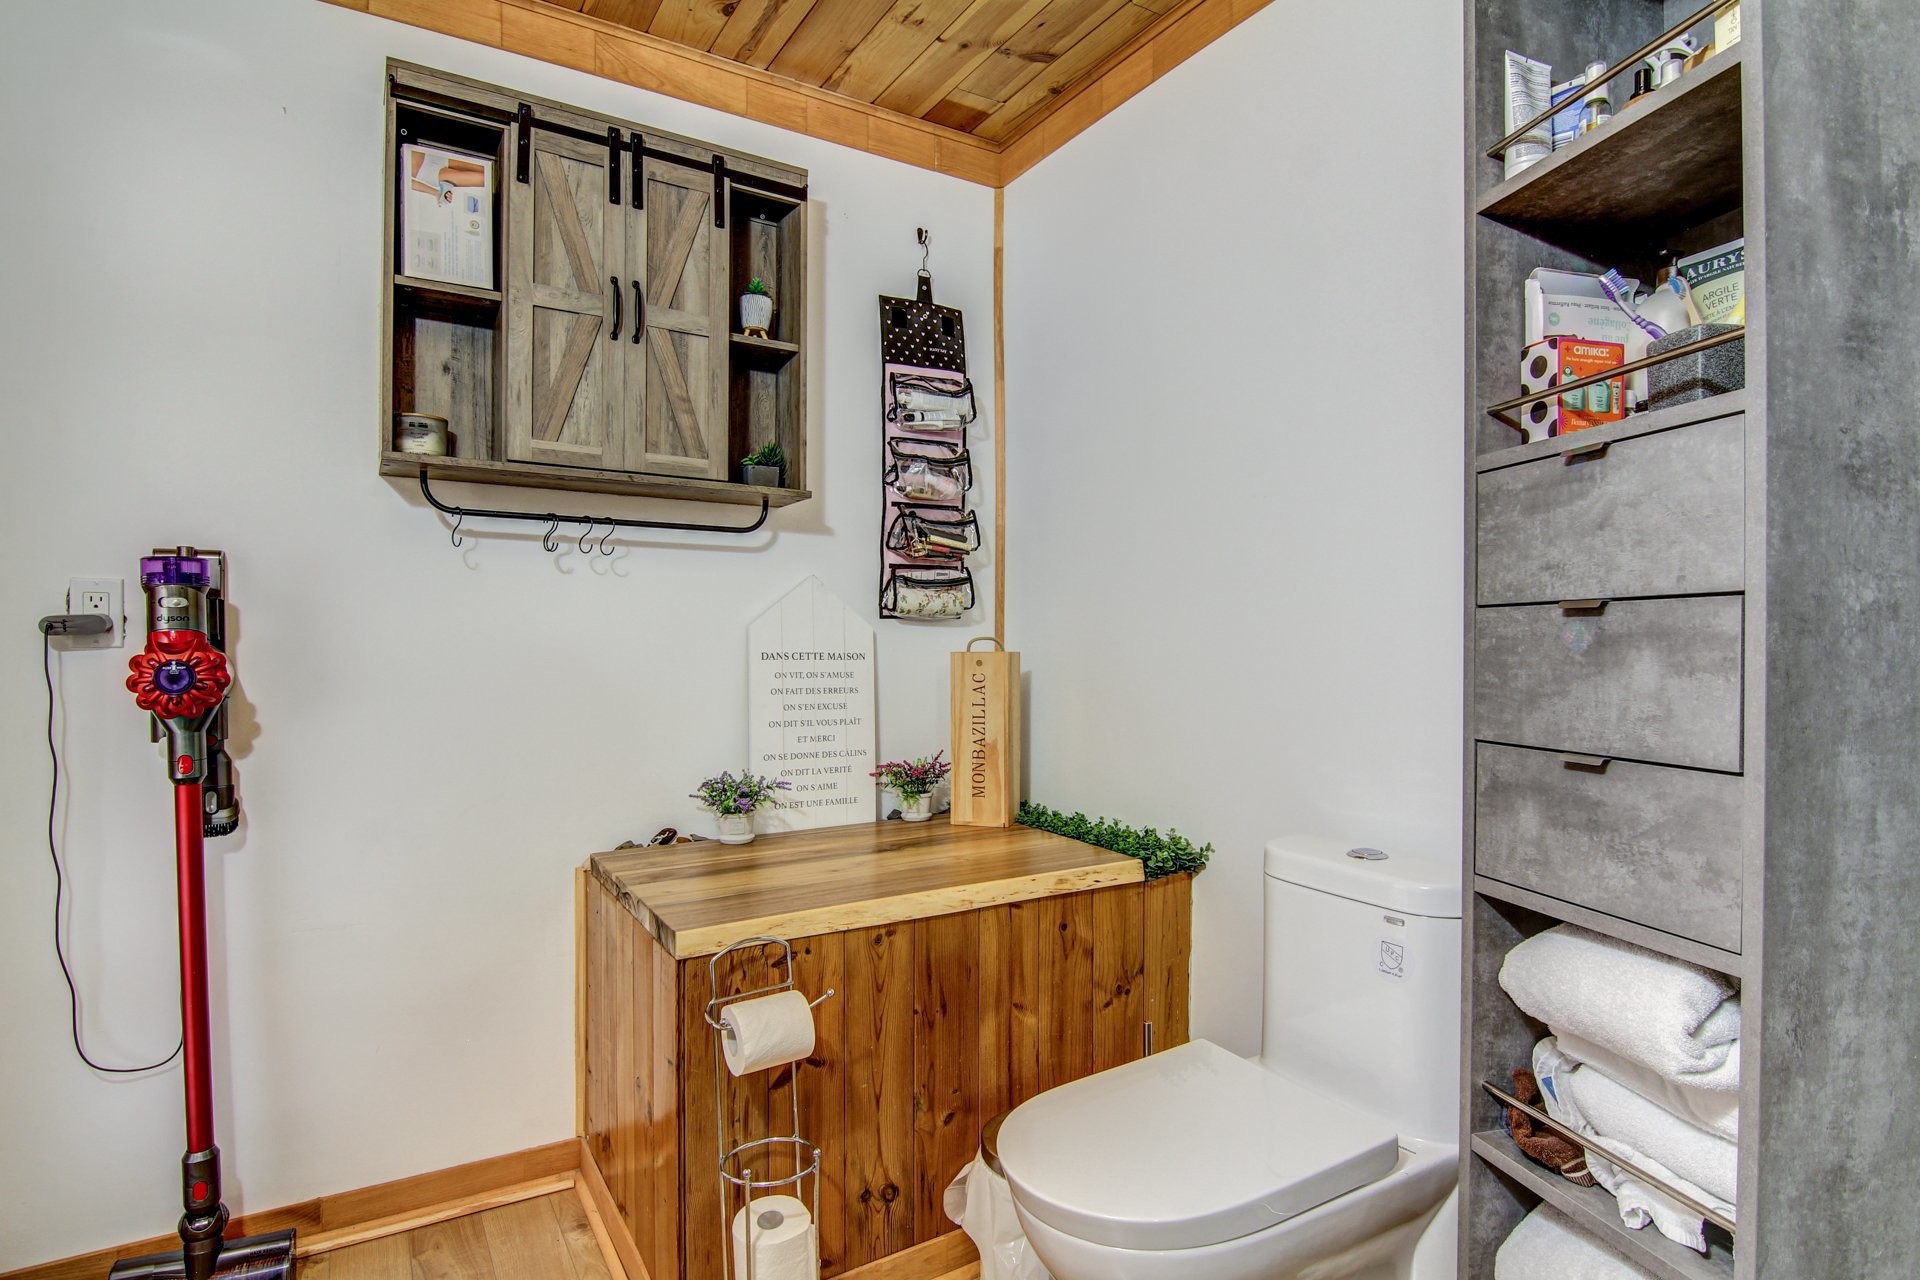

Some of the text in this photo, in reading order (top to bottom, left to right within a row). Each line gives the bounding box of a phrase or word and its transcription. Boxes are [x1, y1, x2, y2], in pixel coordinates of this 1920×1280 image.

[1702, 282, 1739, 302] ARGILE
[1704, 292, 1738, 310] VERTE
[156, 613, 190, 623] dyson
[761, 652, 866, 661] DANS CETTE MAISON
[774, 671, 854, 680] ON VIT, ON S'AMUSE
[785, 687, 804, 695] FAIT
[805, 687, 821, 695] DES
[823, 687, 859, 695] ERREURS
[783, 702, 848, 711] ON S'EN EXCUSE
[768, 720, 781, 728] ON
[800, 719, 814, 727] S'IL
[972, 672, 986, 799] MONBAZILLAC
[790, 751, 820, 760] DONNE
[781, 769, 793, 777] ON
[795, 768, 810, 776] DIT
[796, 784, 809, 792] ON
[774, 802, 787, 810] ON
[789, 801, 804, 809] EST
[825, 797, 859, 806] FAMILLE
